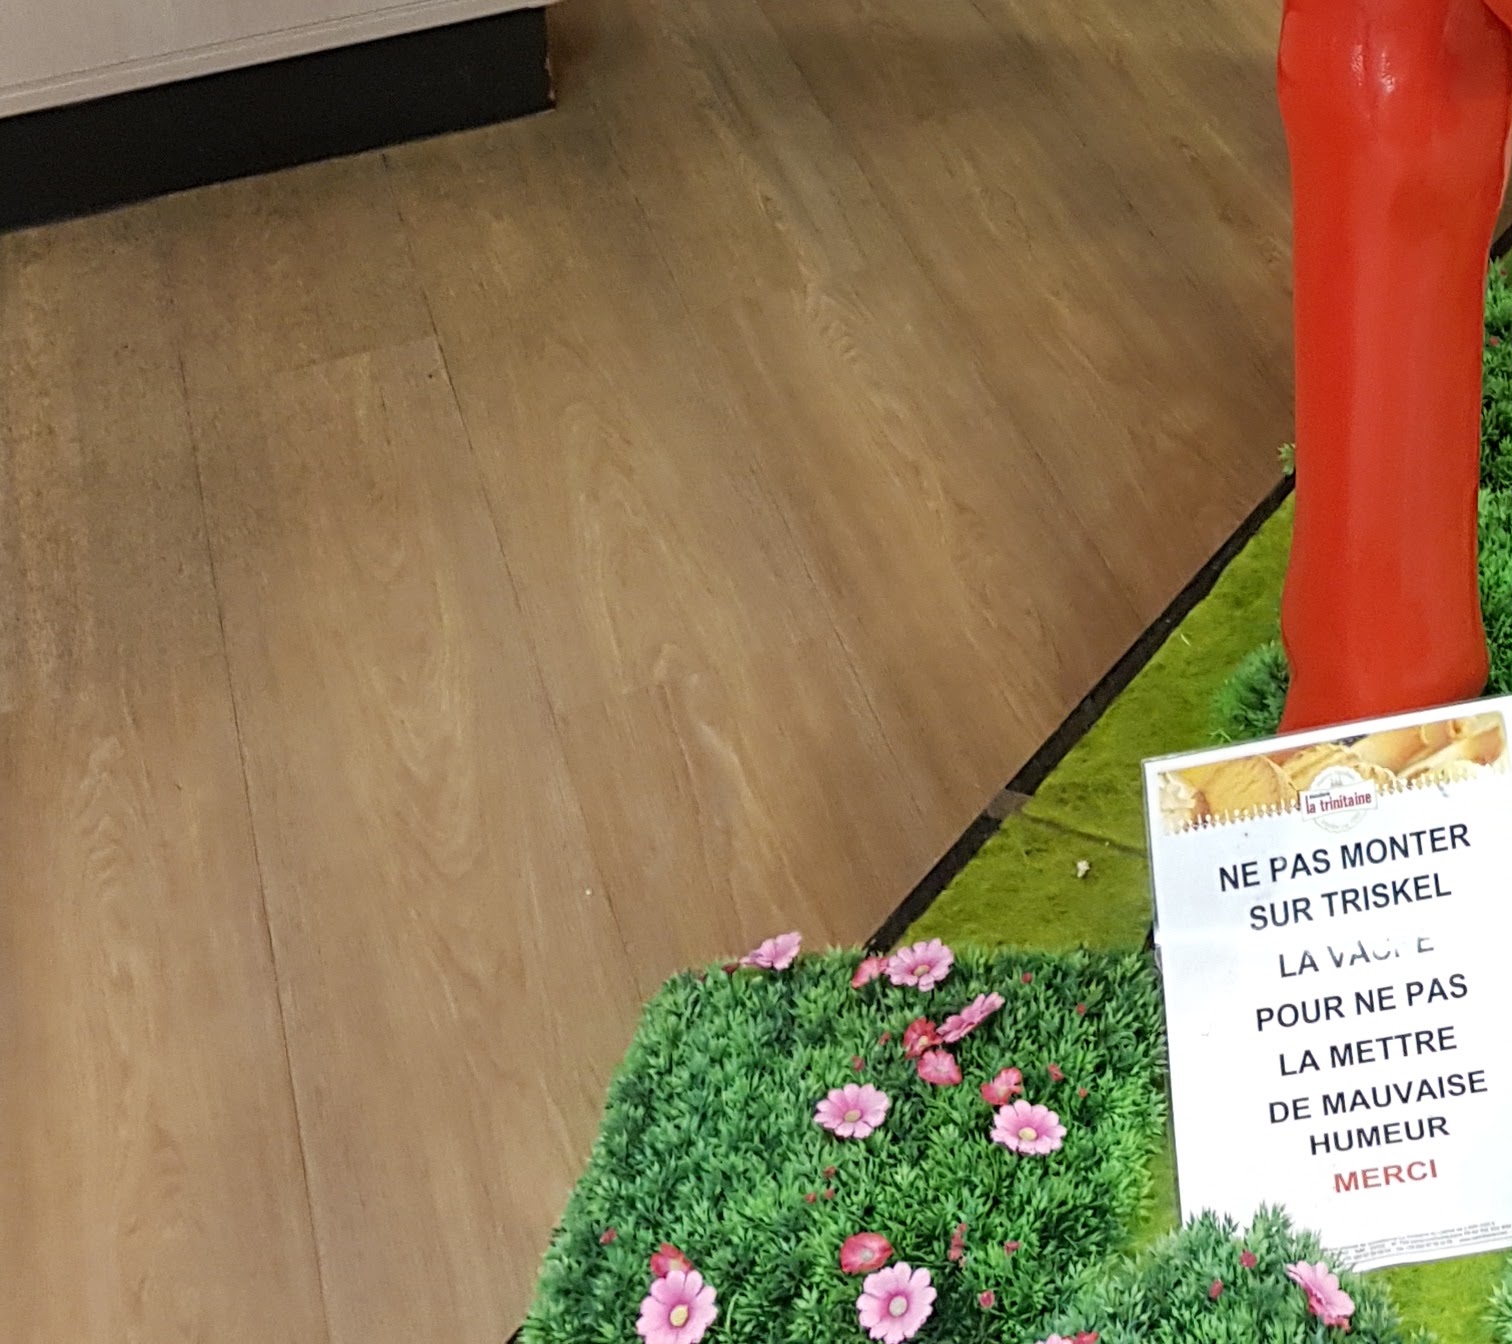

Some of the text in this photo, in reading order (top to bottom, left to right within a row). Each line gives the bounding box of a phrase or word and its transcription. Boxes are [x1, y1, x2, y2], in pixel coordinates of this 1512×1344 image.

[1305, 792, 1372, 814] la trinitaine
[1219, 823, 1471, 892] NE PAS MONTER
[1250, 873, 1452, 931] SUR TRISKEL
[1279, 950, 1319, 978] LA
[1256, 973, 1468, 1032] POUR NE PAS
[1279, 1025, 1457, 1076] LA METTRE
[1269, 1069, 1488, 1124] DE MAUVAISE
[1309, 1116, 1450, 1155] HUMEUR
[1333, 1159, 1438, 1193] MERCI
